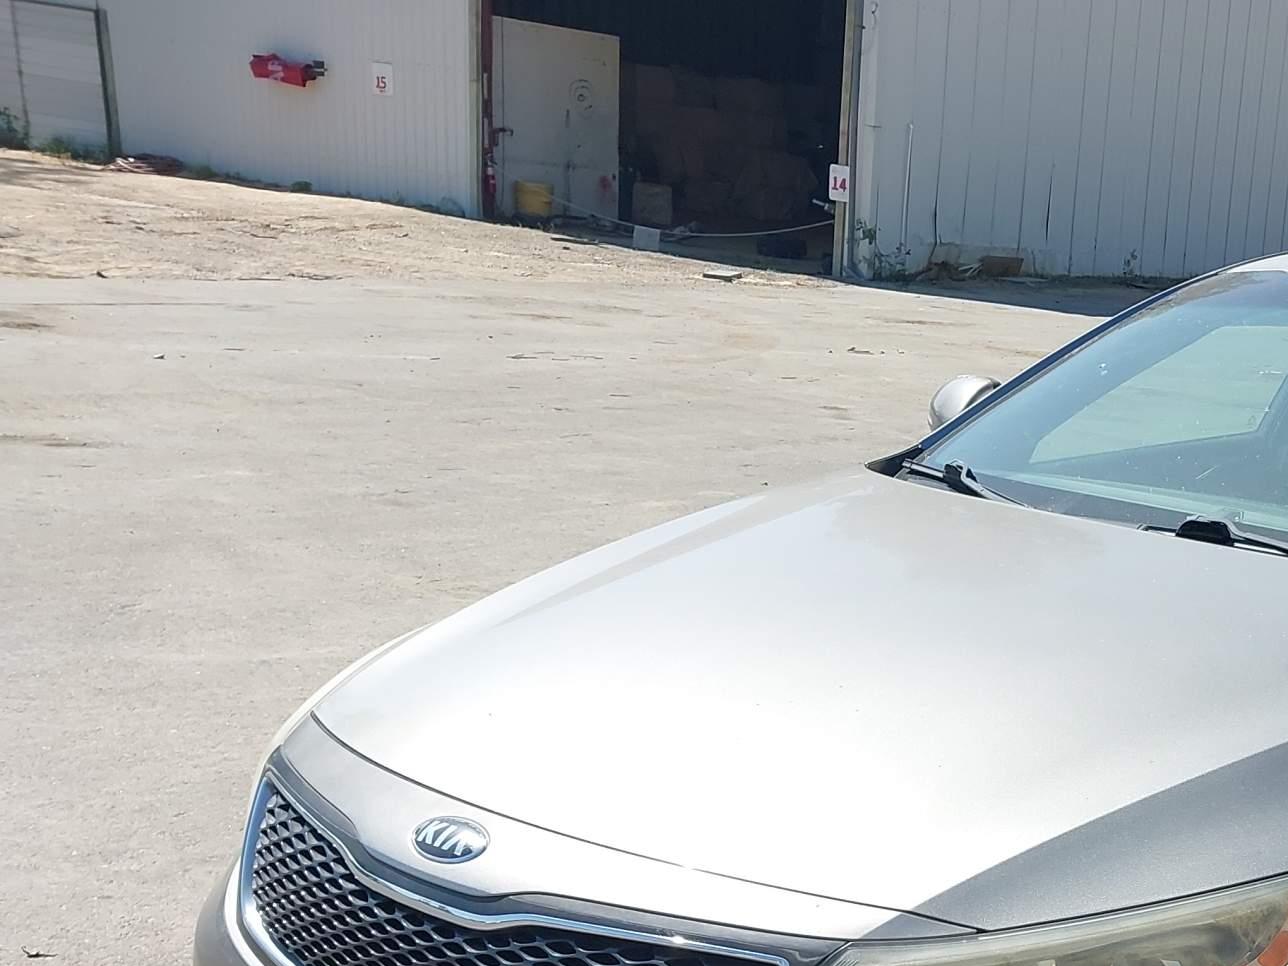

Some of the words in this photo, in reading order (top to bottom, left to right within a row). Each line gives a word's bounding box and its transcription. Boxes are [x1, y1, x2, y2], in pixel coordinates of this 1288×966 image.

[376, 76, 387, 89] 15
[832, 176, 847, 192] 14
[415, 820, 474, 857] KIA
